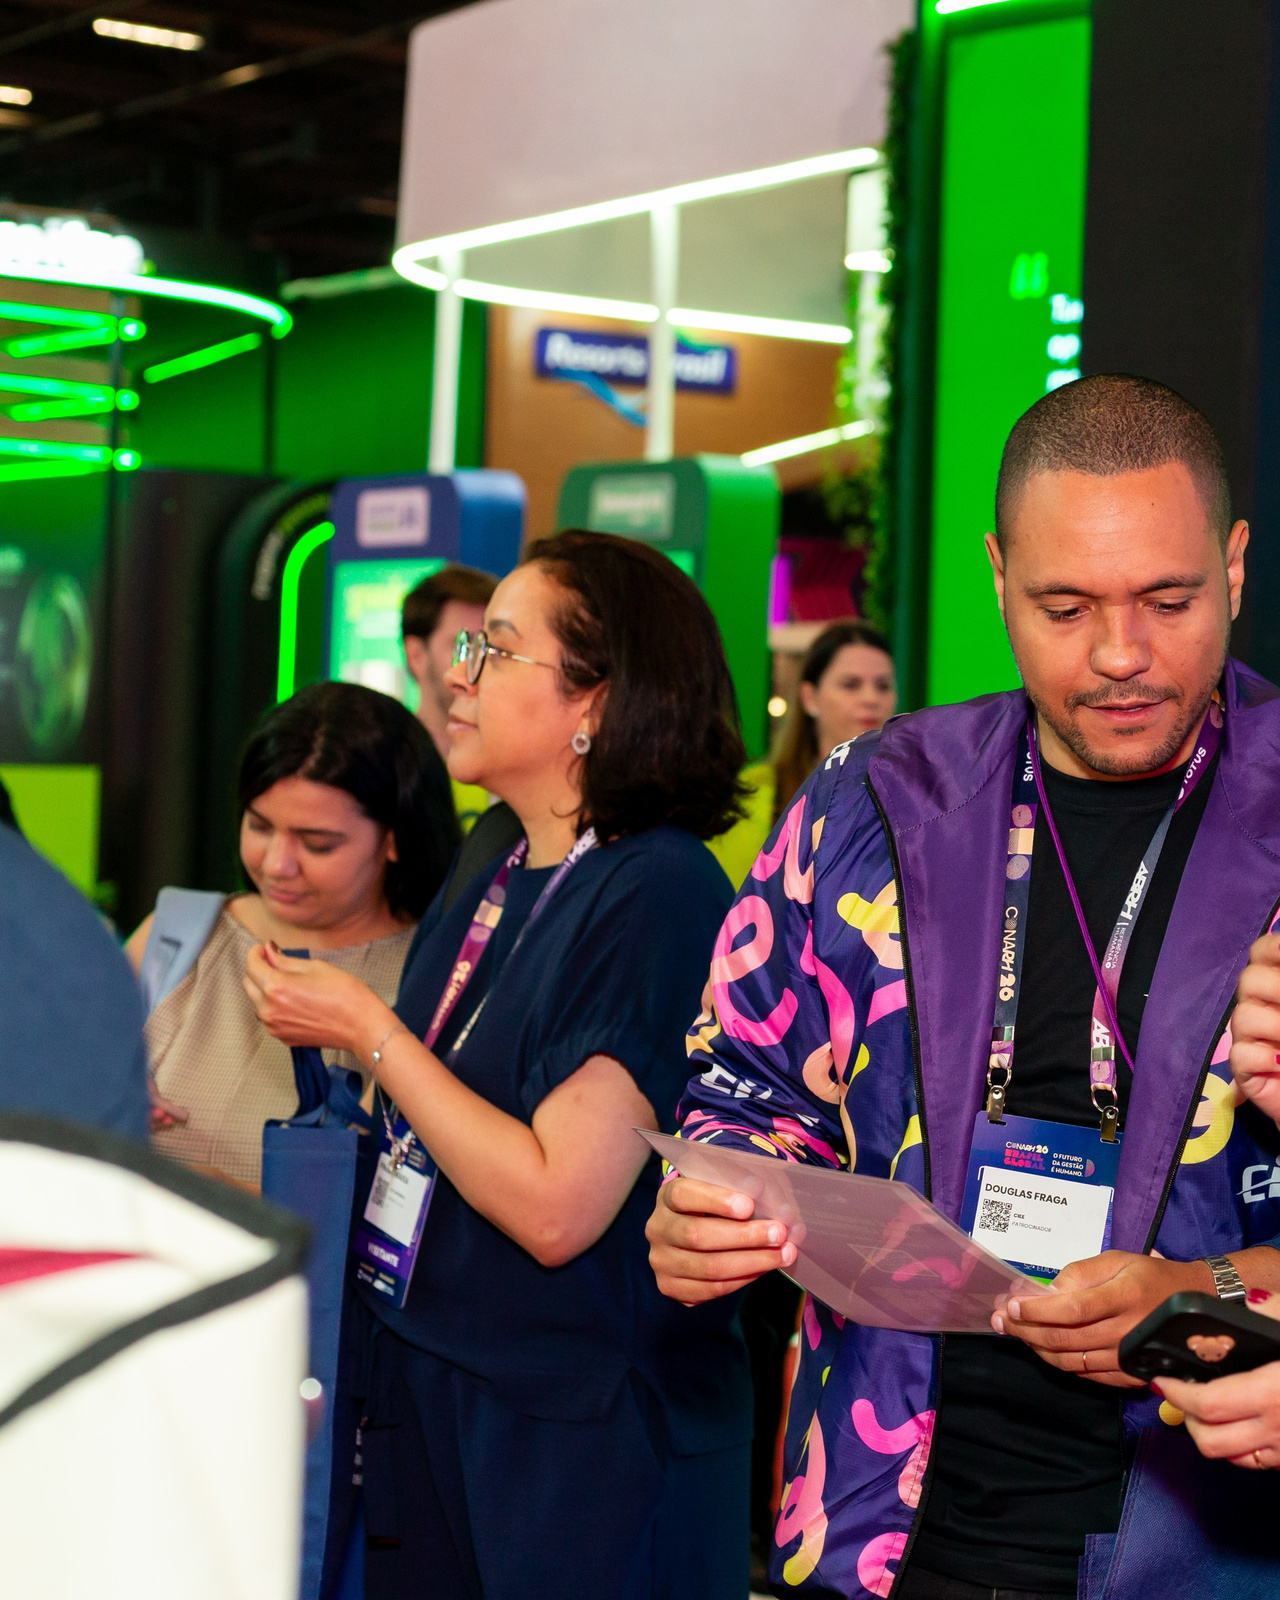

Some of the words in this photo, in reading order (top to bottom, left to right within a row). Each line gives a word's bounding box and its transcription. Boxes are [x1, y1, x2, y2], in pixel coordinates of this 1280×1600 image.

[1120, 861, 1149, 920] ABRH
[999, 973, 1016, 1002] 26
[1058, 1153, 1083, 1163] FUTURO
[1061, 1160, 1084, 1170] GESTÃO
[985, 1183, 1032, 1199] DOUGLAS
[1034, 1193, 1068, 1206] FRAGA
[1012, 1221, 1052, 1232] PATROCINADOR
